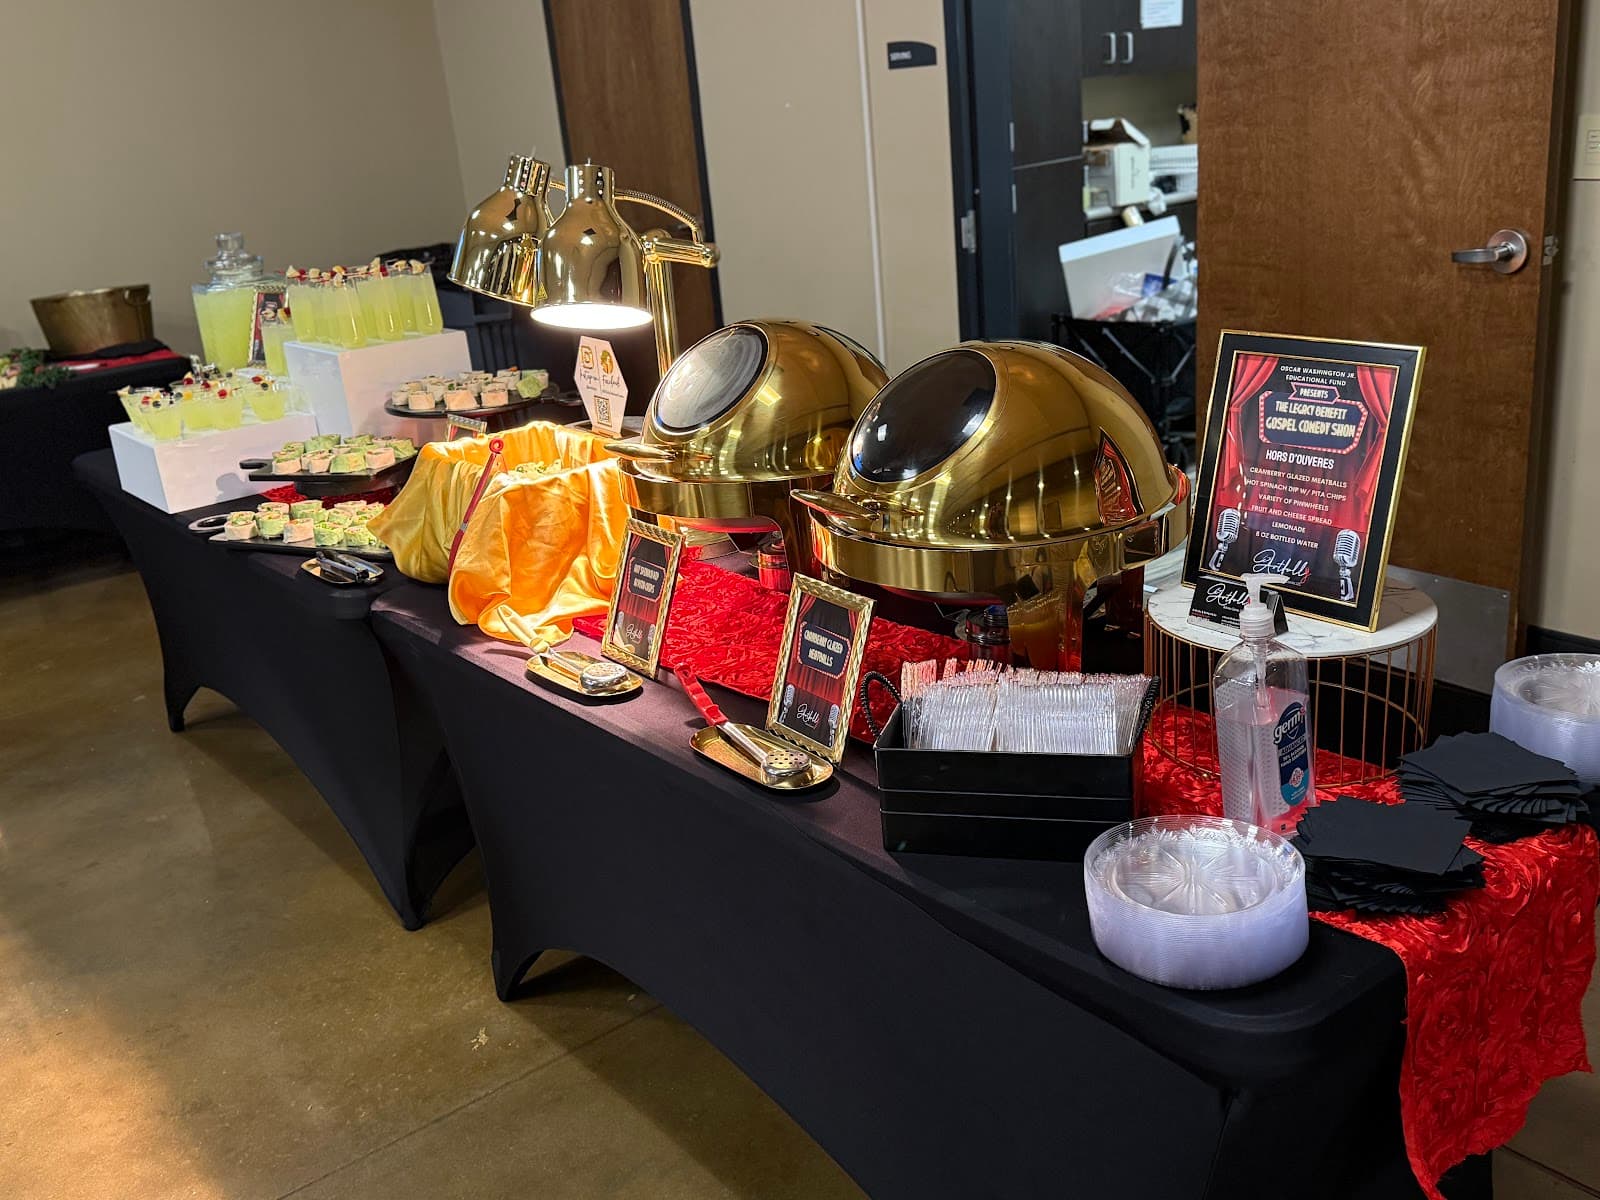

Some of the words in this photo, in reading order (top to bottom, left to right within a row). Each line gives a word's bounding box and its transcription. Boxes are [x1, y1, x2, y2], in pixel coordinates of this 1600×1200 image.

[1280, 365, 1301, 374] OSCAR
[1302, 368, 1346, 378] WASHINGTON
[1286, 375, 1327, 384] EDUCATIONAL
[1299, 387, 1329, 399] PRESENTS
[1275, 401, 1289, 412] THE
[1289, 402, 1314, 416] LEGACY
[1315, 406, 1348, 420] BENEFIT
[1266, 417, 1297, 432] GOSPEL
[1299, 420, 1331, 435] COMEDY
[1331, 424, 1356, 438] SHOW
[1266, 449, 1288, 463] HORS
[1289, 453, 1335, 469] D'OUVERES
[1250, 467, 1286, 478] CRANBERRY
[1286, 472, 1310, 482] GLAZED
[1311, 477, 1347, 488] MEATBALLS
[1260, 481, 1287, 491] SPINACH
[1288, 485, 1299, 493] DIP
[1300, 487, 1310, 496] W/
[1311, 490, 1325, 498] PITA
[1326, 492, 1347, 501] CHIPS
[1258, 494, 1283, 503] VARIETY
[1293, 500, 1329, 511] PINWHEELS
[1251, 505, 1267, 513] FRUIT
[1267, 507, 1282, 516] AND
[1283, 510, 1307, 521] CHEESE
[1308, 515, 1333, 526] SPREAD
[1271, 521, 1306, 534] LEMONADE
[1270, 533, 1296, 545] BOTTLED
[1297, 538, 1319, 549] WATER
[804, 629, 828, 647] CRANBERRY
[827, 639, 844, 654] GLAZED
[808, 648, 833, 667] MEATBALLS
